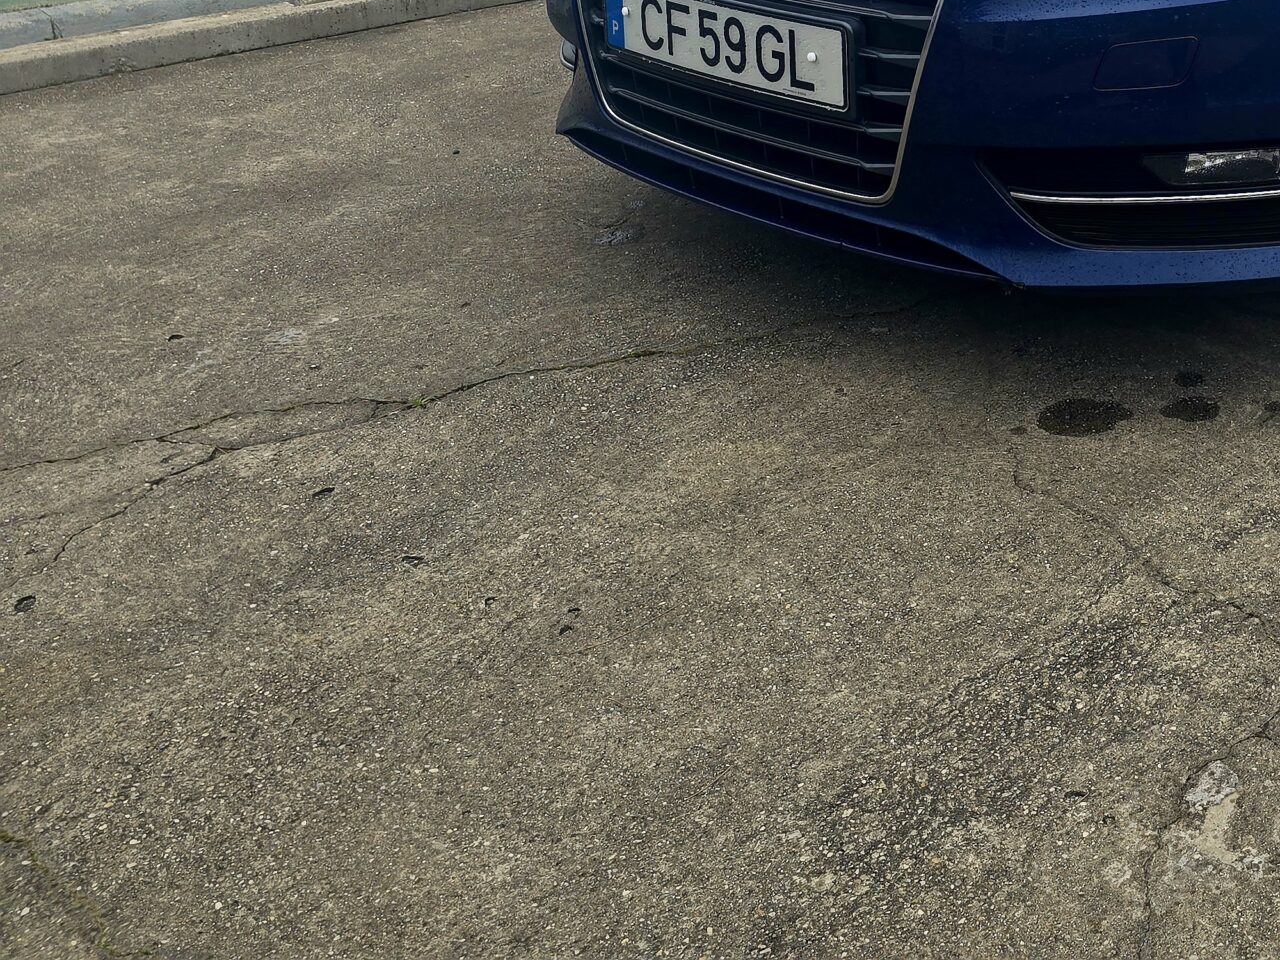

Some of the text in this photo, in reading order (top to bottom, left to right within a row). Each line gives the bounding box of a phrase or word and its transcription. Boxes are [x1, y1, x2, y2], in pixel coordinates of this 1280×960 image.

[612, 19, 619, 35] P
[697, 8, 747, 74] 59
[755, 24, 816, 93] GL
